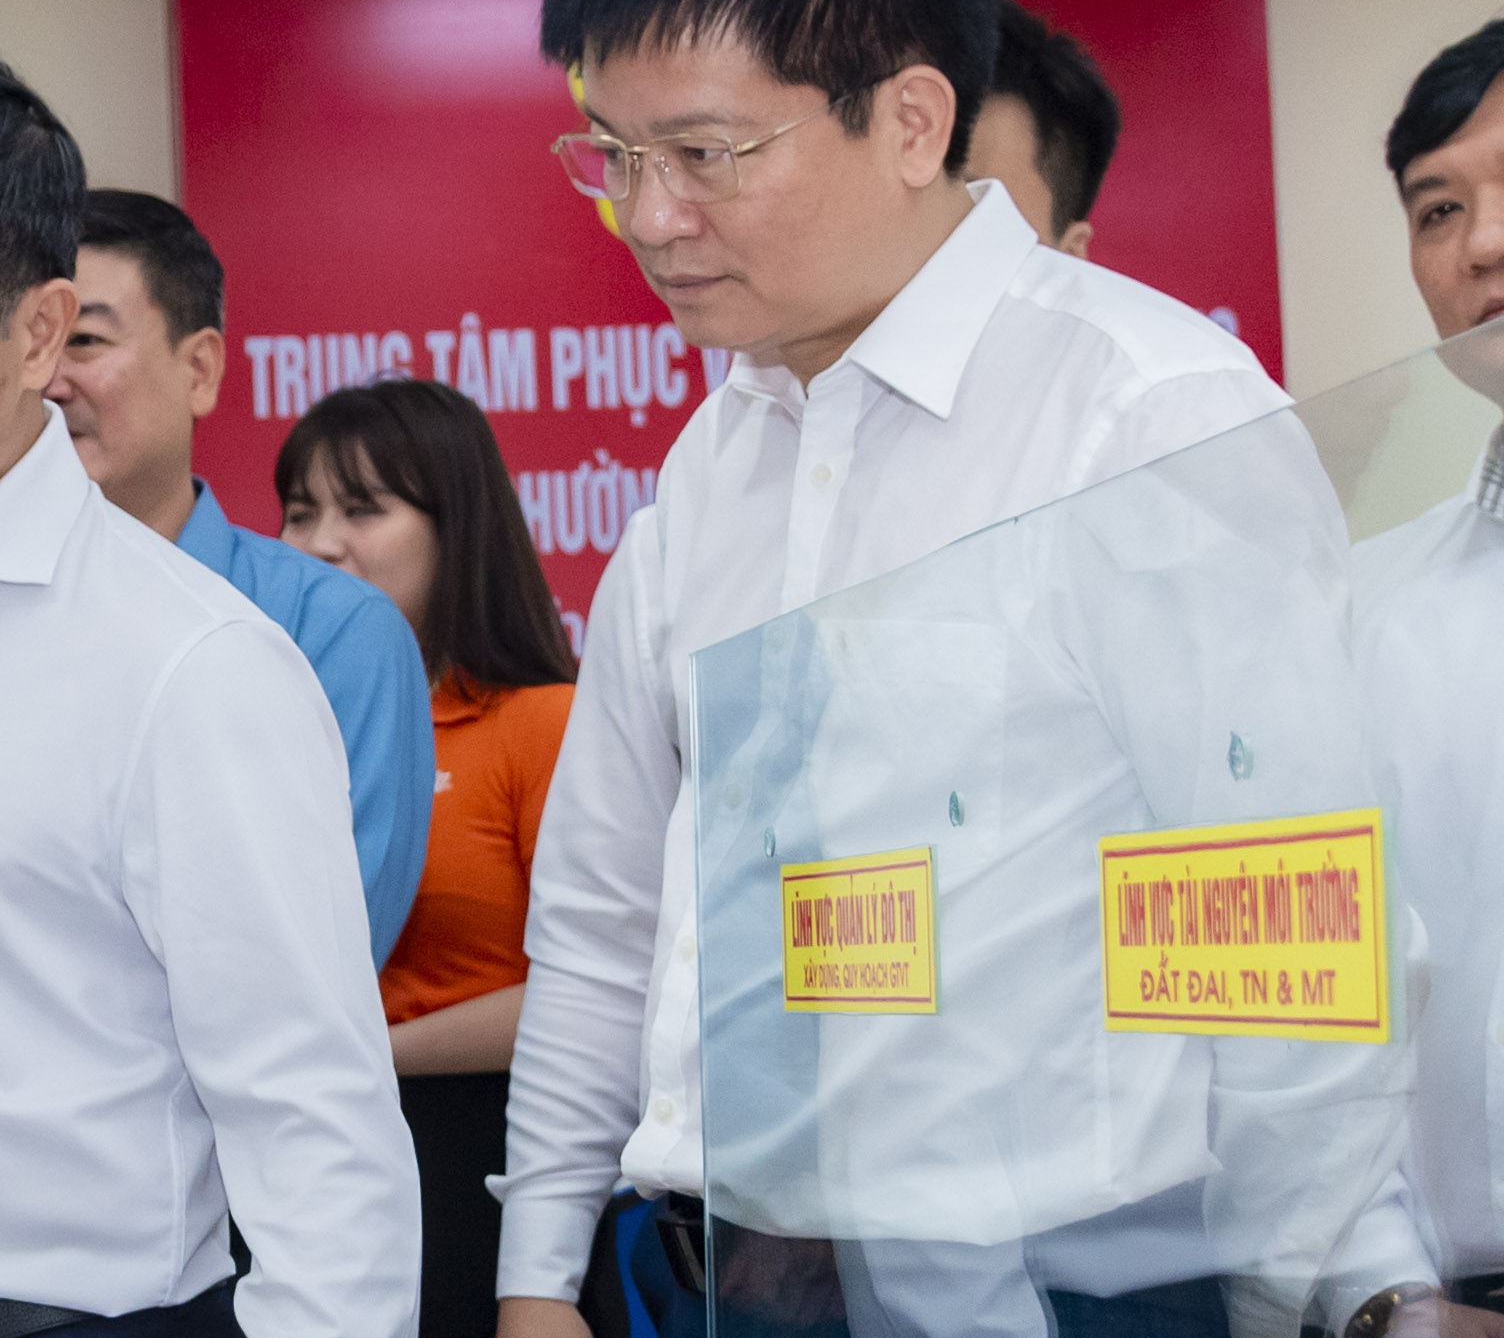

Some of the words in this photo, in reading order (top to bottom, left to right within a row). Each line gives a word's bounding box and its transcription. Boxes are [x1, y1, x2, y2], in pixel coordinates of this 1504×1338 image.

[244, 329, 414, 421] TRUNG
[424, 311, 539, 412] TÂM
[549, 323, 689, 428] PHỤC
[791, 890, 813, 948] LĨNH
[814, 893, 834, 958] VỰC
[836, 874, 864, 952] QUẢN
[865, 881, 878, 945] LÝ
[880, 880, 896, 944] ĐÔ
[897, 888, 917, 956] THỊ
[1117, 869, 1147, 947] LĨNH
[1177, 863, 1199, 946] TÀI
[1201, 860, 1260, 945] NGUYÊN
[1262, 856, 1293, 944] MÔI
[1294, 848, 1361, 943] TRƯỜNG
[803, 957, 818, 989] XÂY
[859, 961, 888, 994] HOẠCH
[889, 961, 910, 989] GTVT
[1139, 949, 1180, 1004] ĐẤT
[1186, 968, 1233, 1010] ĐAI,
[1239, 968, 1268, 1005] TN
[1275, 968, 1293, 1005] &
[1299, 968, 1336, 1006] MT
